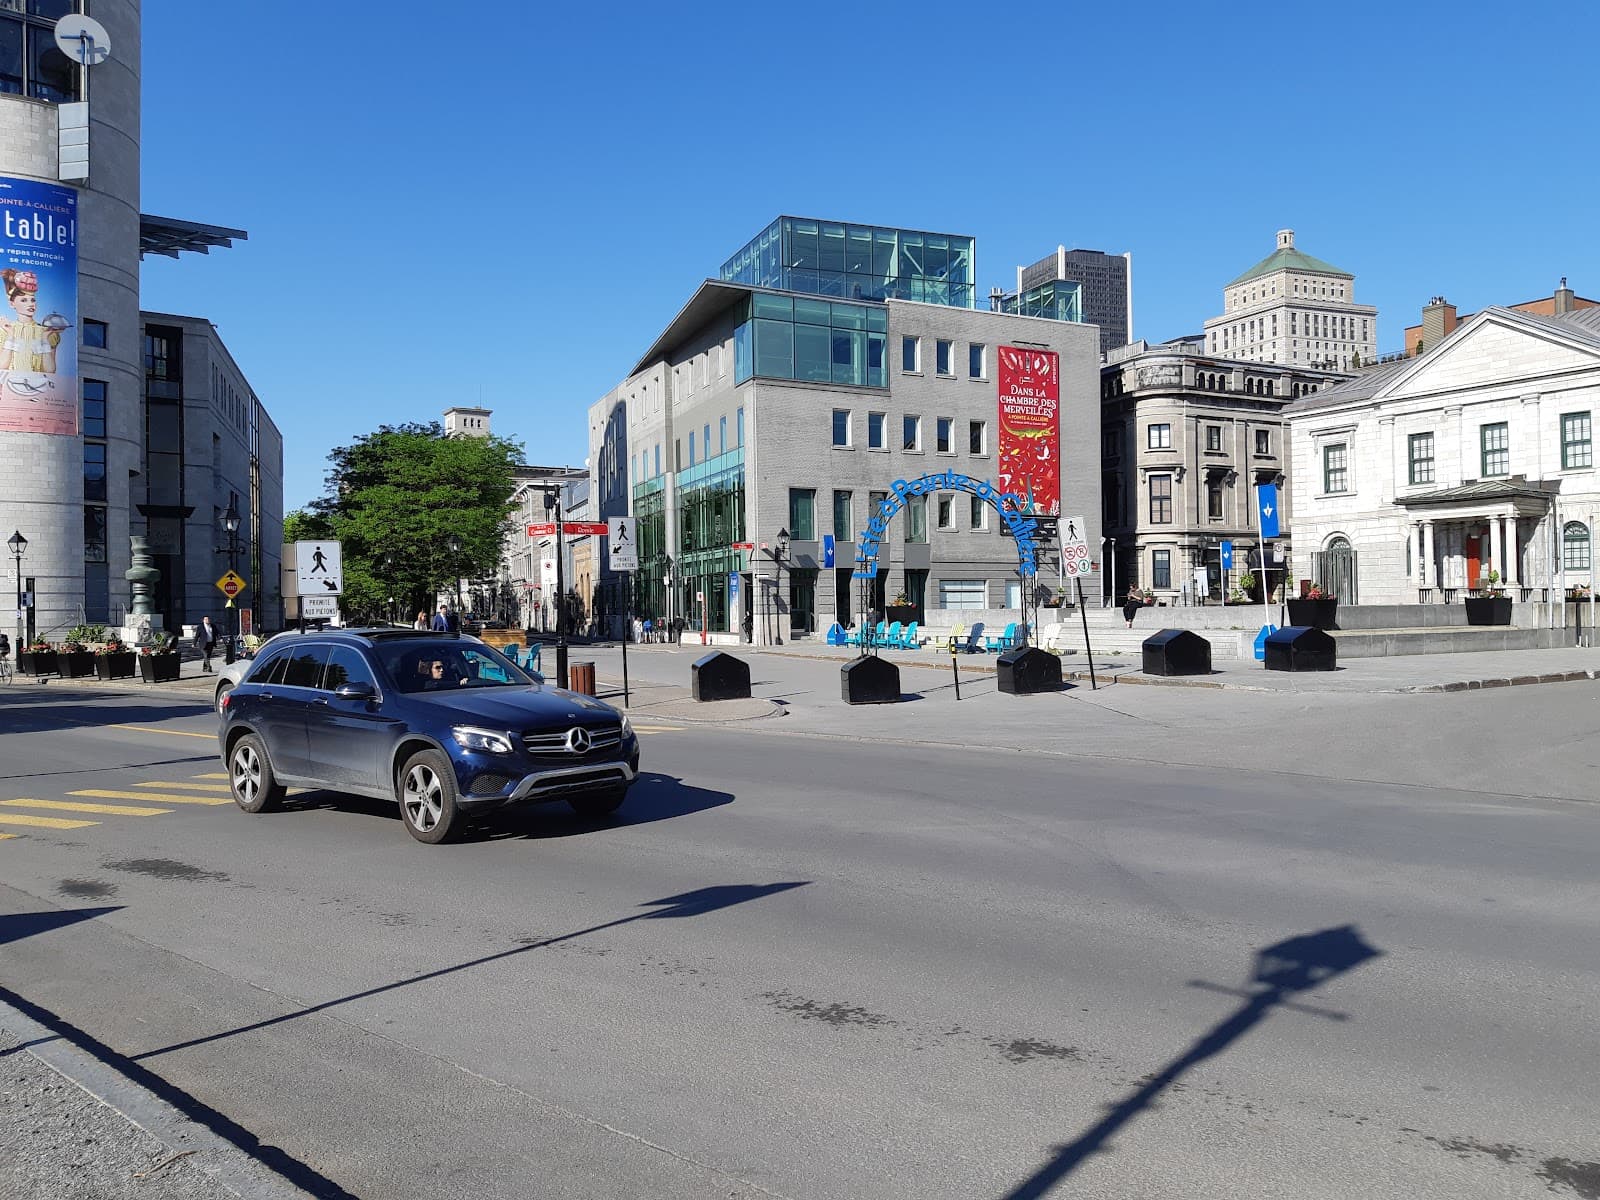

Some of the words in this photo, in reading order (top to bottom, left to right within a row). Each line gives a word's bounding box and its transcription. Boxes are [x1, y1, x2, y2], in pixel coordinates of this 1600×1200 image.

[6, 210, 74, 247] table!
[7, 248, 31, 256] repas
[33, 251, 64, 261] français
[22, 258, 53, 267] raconte
[1010, 384, 1034, 396] DANS
[1035, 388, 1046, 398] LA
[1000, 395, 1039, 406] CHAMBRE
[1041, 399, 1057, 410] DES
[1003, 405, 1053, 418] MERVEILLES
